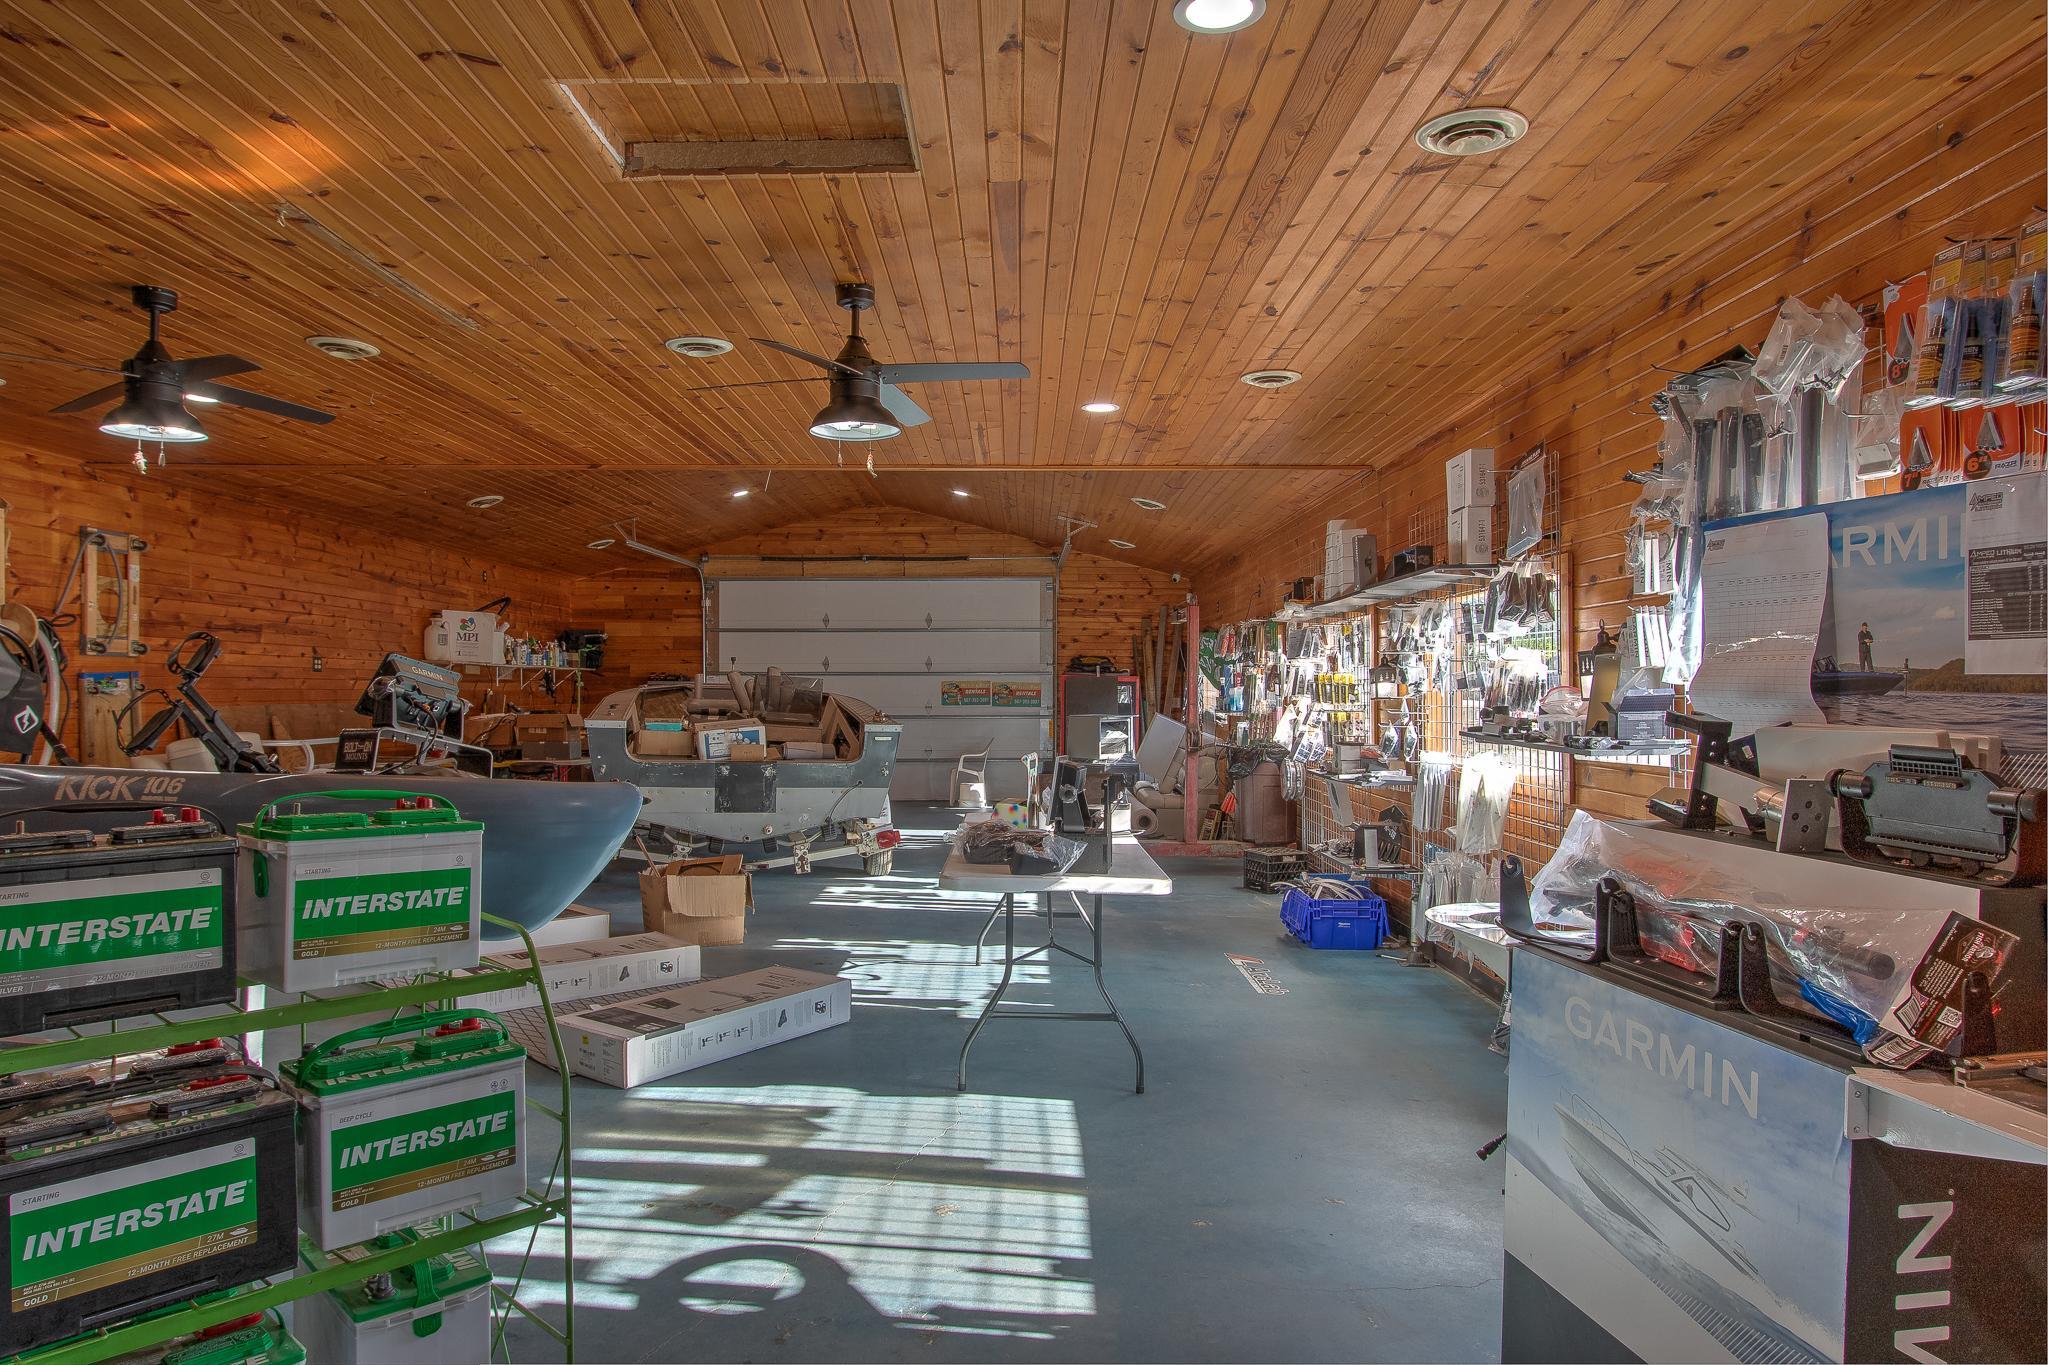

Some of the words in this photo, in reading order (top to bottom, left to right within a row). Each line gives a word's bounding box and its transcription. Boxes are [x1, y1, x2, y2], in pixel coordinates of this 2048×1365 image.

[1967, 454, 1988, 472] 6"
[1829, 513, 1968, 569] RMI
[455, 631, 480, 642] MPI
[411, 666, 444, 681] GARMIN
[345, 752, 368, 761] MOUNTS
[54, 774, 145, 801] KICK
[142, 776, 186, 794] 106
[0, 891, 30, 900] TARTING
[302, 886, 466, 920] INTERSTATE
[433, 925, 447, 933] 24M
[375, 940, 407, 949] 12-MONTH
[406, 937, 422, 946] FREE
[422, 933, 464, 945] REPLACEMENT
[301, 949, 320, 958] GOLD
[1564, 996, 1759, 1120] GARMIN
[339, 1114, 354, 1124] DEEP
[355, 1111, 373, 1120] CYCLE
[339, 1110, 508, 1169] INTERSTATE
[417, 1175, 450, 1188] 12-MONTH
[449, 1169, 466, 1180] FREE
[466, 1159, 509, 1177] REPLACEMENT
[22, 1191, 60, 1206] STARTING
[341, 1198, 359, 1208] GOLD
[22, 1180, 248, 1262] INTERSTATE
[206, 1232, 225, 1243] 27M
[127, 1260, 171, 1277] 12-MONTH
[172, 1253, 192, 1264] FREE
[193, 1236, 249, 1257] REPLACEMENT
[23, 1294, 49, 1307] GOLD
